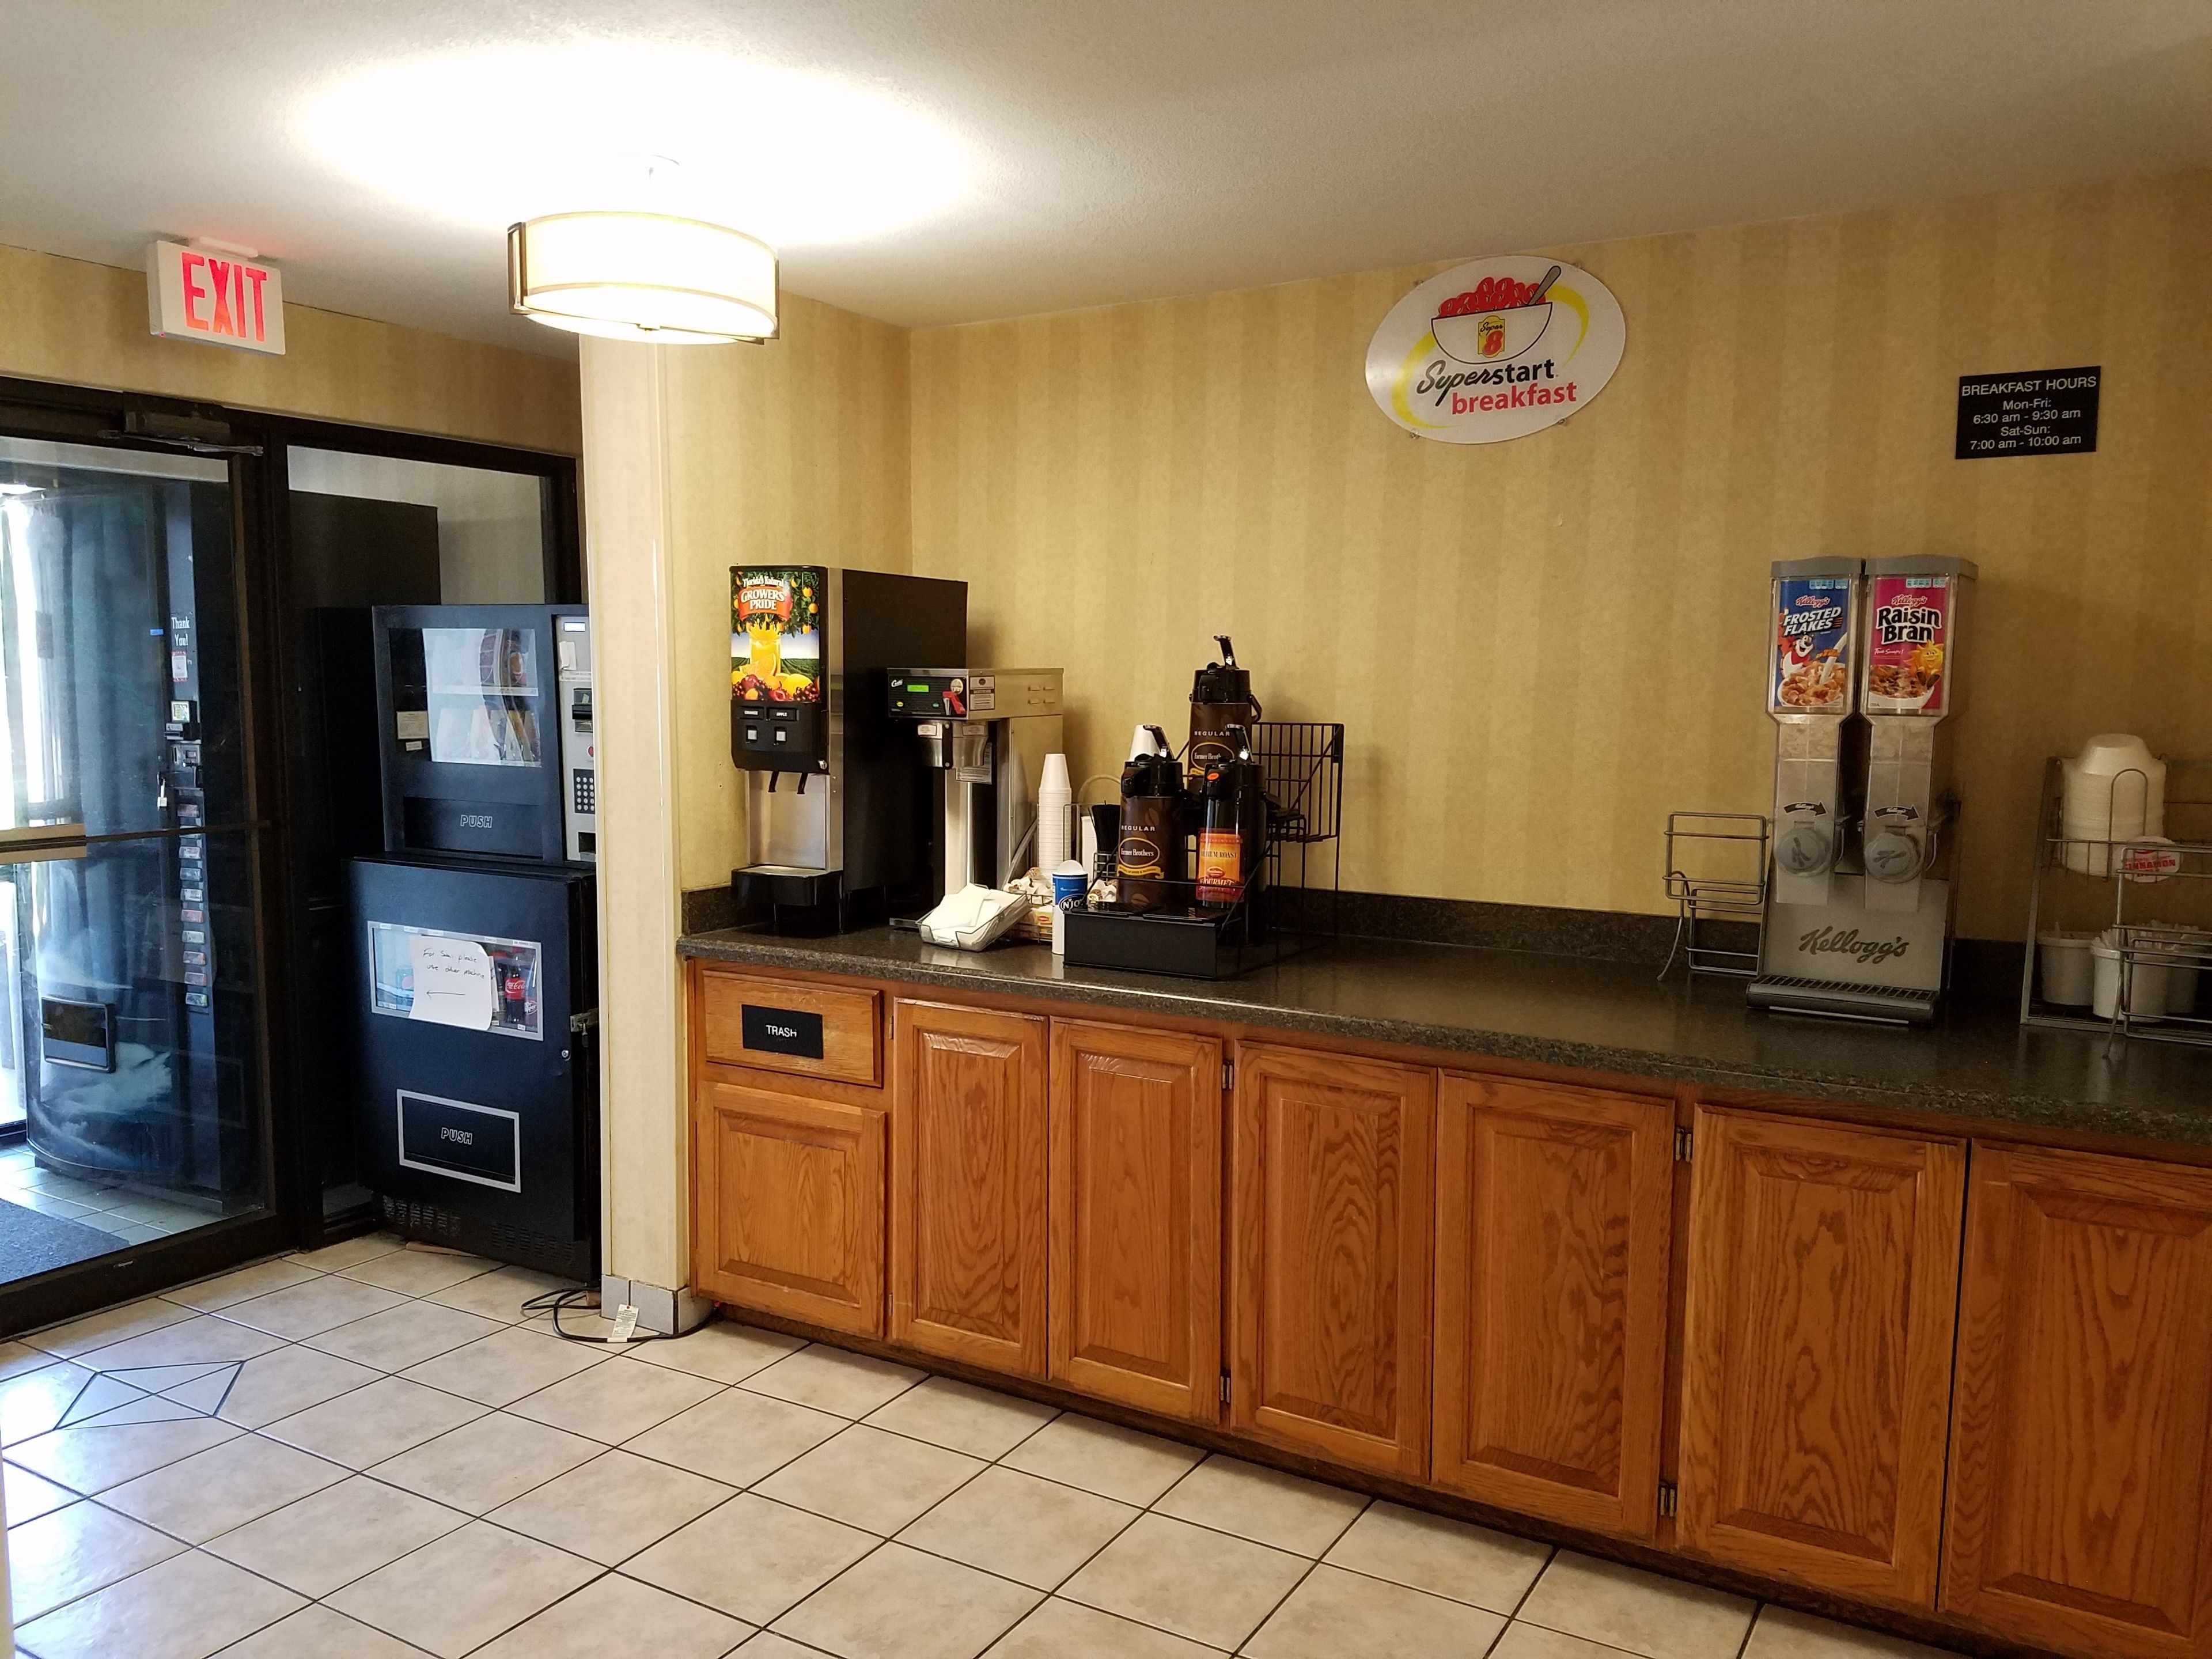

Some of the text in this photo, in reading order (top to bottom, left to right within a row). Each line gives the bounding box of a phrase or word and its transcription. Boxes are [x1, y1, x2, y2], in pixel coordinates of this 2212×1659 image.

[181, 252, 267, 342] EXIT
[1480, 322, 1504, 336] Super
[1482, 330, 1504, 355] 8
[1416, 358, 1555, 407] Superstart
[1961, 376, 2097, 396] BREAKFAST HOURS
[1452, 381, 1577, 415] breakfast
[2003, 397, 2051, 410] Mon-Fri:
[1973, 414, 1998, 424] 6:30
[2002, 414, 2020, 422] am
[2032, 410, 2058, 421] 9:30
[2062, 410, 2081, 419] am
[2001, 425, 2050, 436] Sat-Sun:
[1970, 440, 1995, 450] 7:00
[1998, 440, 2017, 449] am
[2028, 435, 2060, 446] 10:00
[2062, 436, 2081, 445] am
[750, 600, 777, 610] PRIDE
[1796, 596, 1830, 608] Kellogg's
[1891, 594, 1927, 607] Kellogg's
[172, 616, 190, 630] Thank
[1783, 607, 1841, 626] FROSTED
[1877, 607, 1941, 628] Raisin
[1784, 618, 1833, 636] FLAKES
[1883, 625, 1933, 643] Bran
[175, 634, 188, 646] You!
[460, 814, 493, 828] PUSH
[1132, 849, 1154, 857] Brothers
[1799, 925, 1910, 965] Kellogg's
[423, 948, 434, 957] For
[458, 955, 477, 964] please
[765, 1024, 797, 1037] TRASH
[441, 1127, 472, 1145] PUSH
